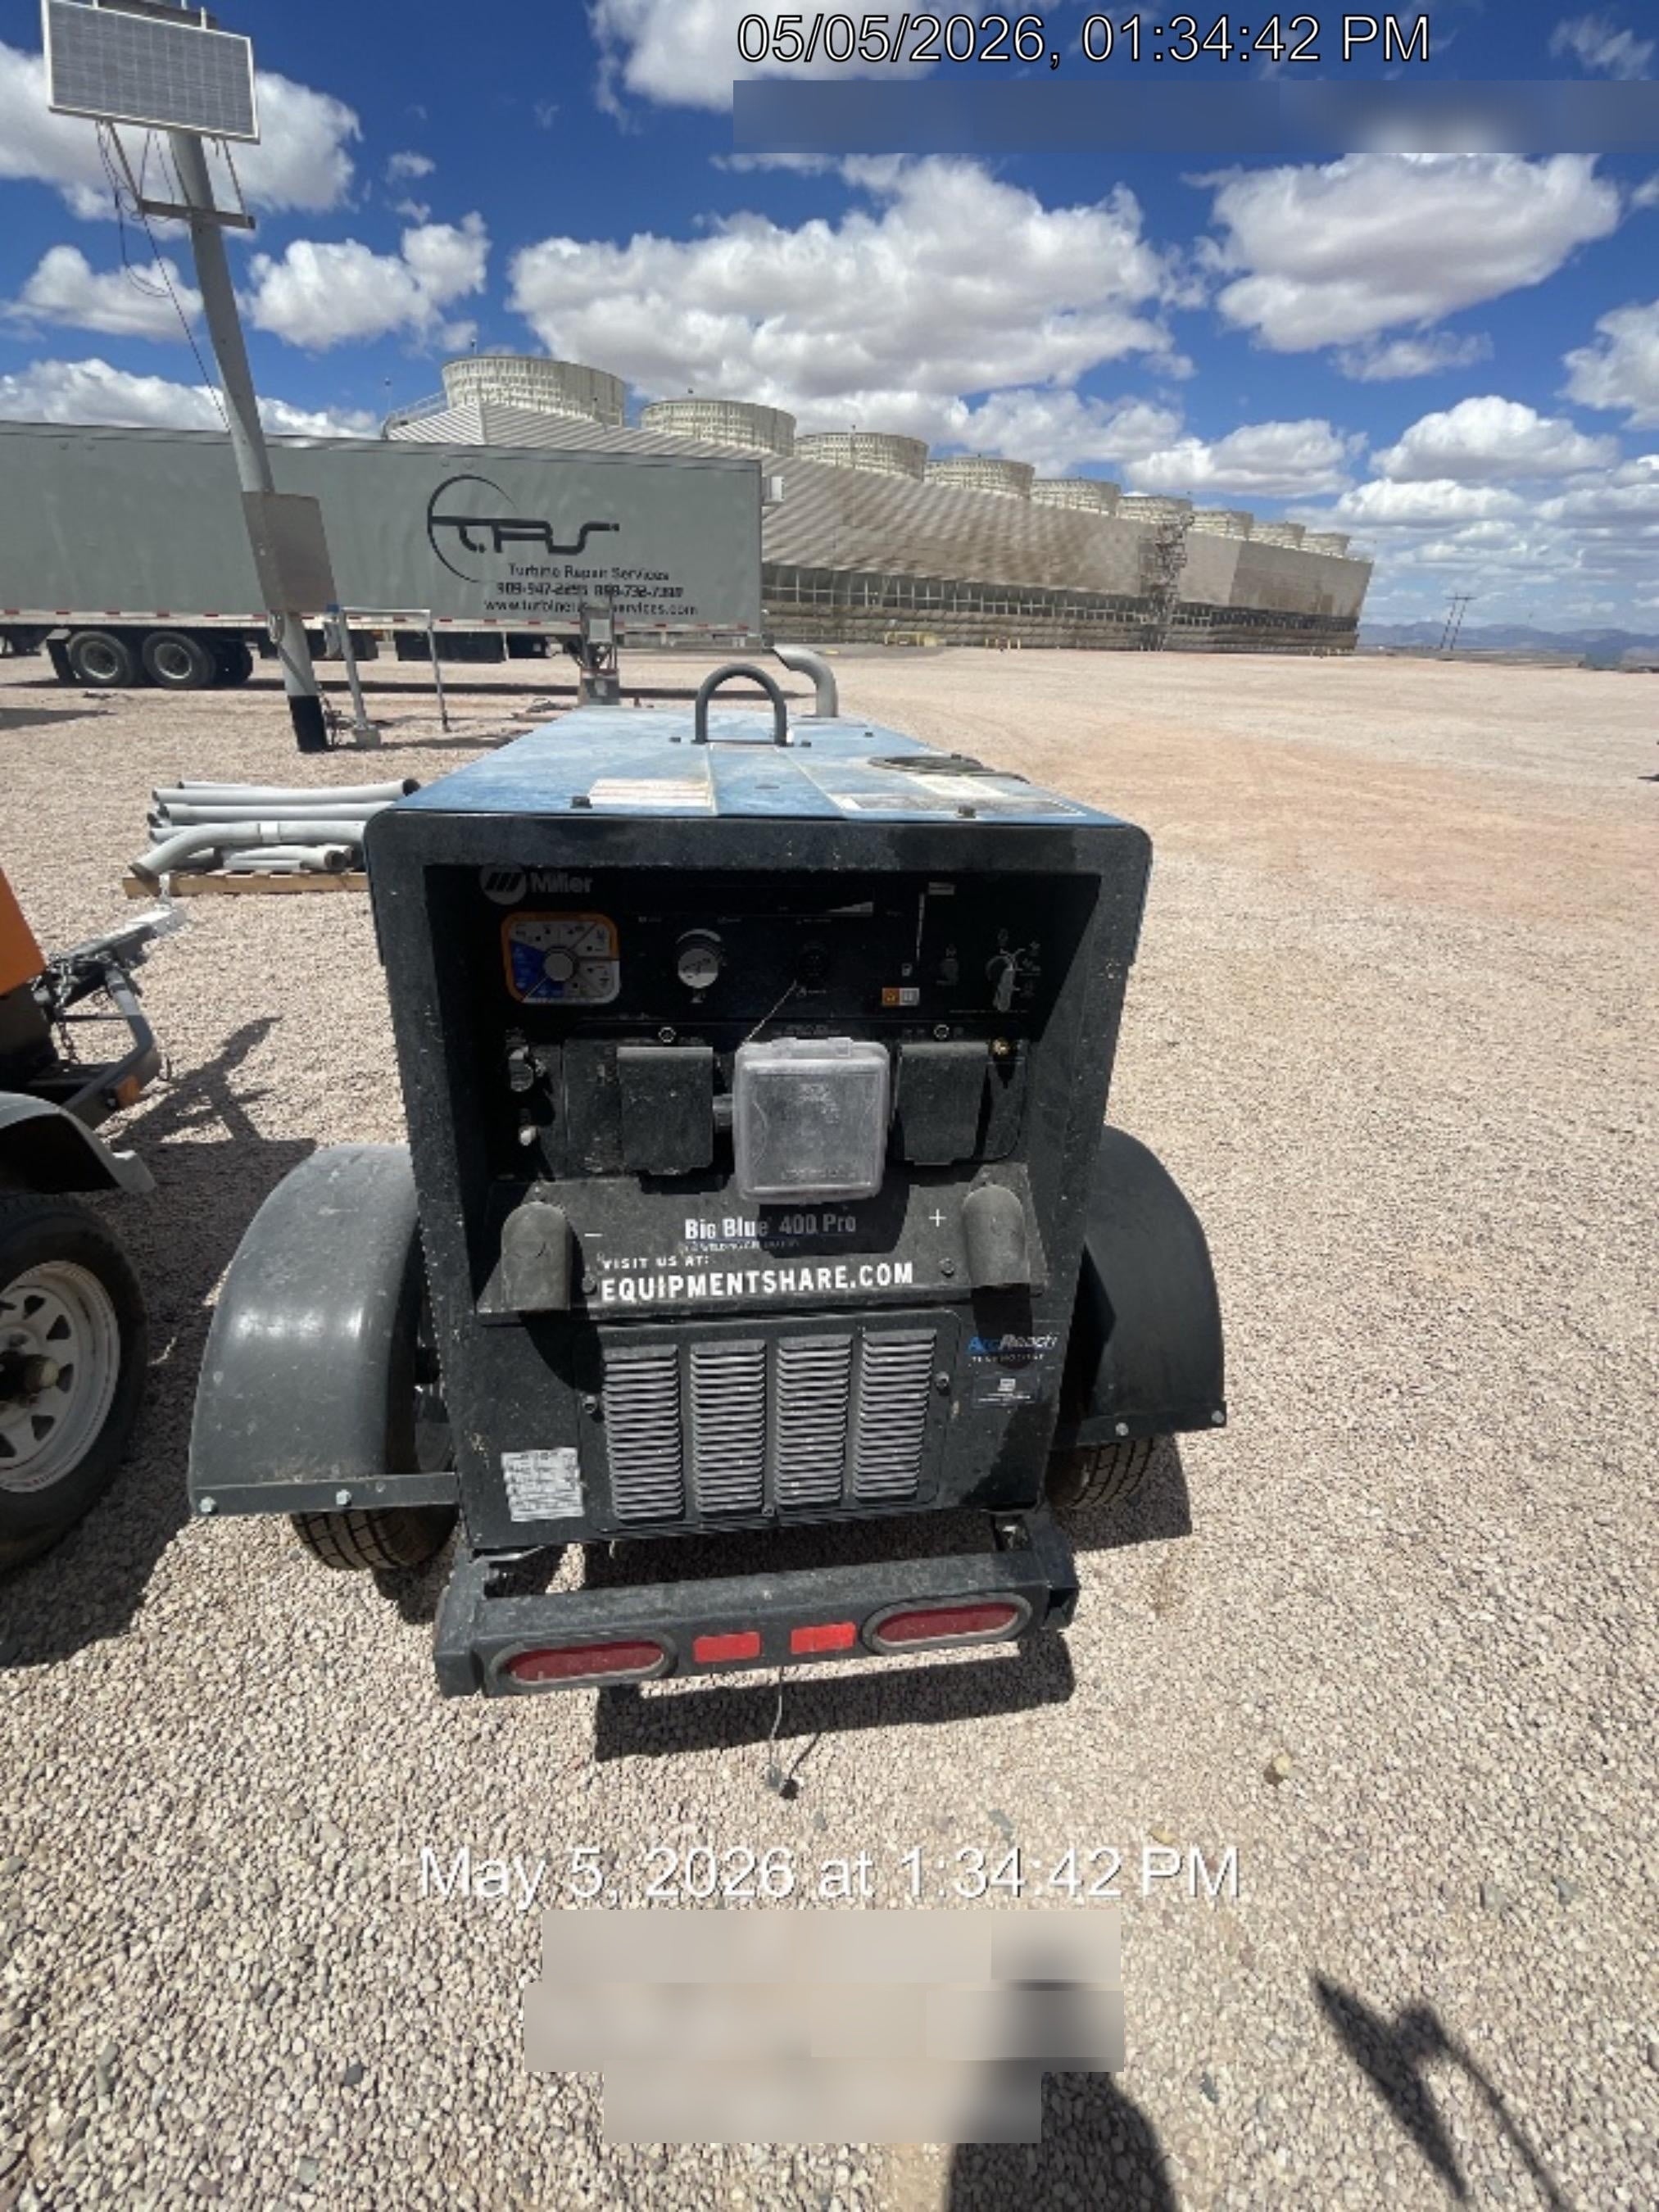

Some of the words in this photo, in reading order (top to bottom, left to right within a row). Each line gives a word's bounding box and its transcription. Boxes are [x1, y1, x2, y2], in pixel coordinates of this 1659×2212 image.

[530, 871, 593, 894] Miller
[683, 1218, 717, 1240] Big
[722, 1216, 768, 1238] Blue
[778, 1214, 818, 1235] 400
[822, 1213, 857, 1234] Pro
[603, 1257, 648, 1271] VISIT
[656, 1255, 678, 1268] US
[685, 1253, 709, 1267] AT:
[601, 1262, 913, 1303] EQUIPMENTSHARE.COM
